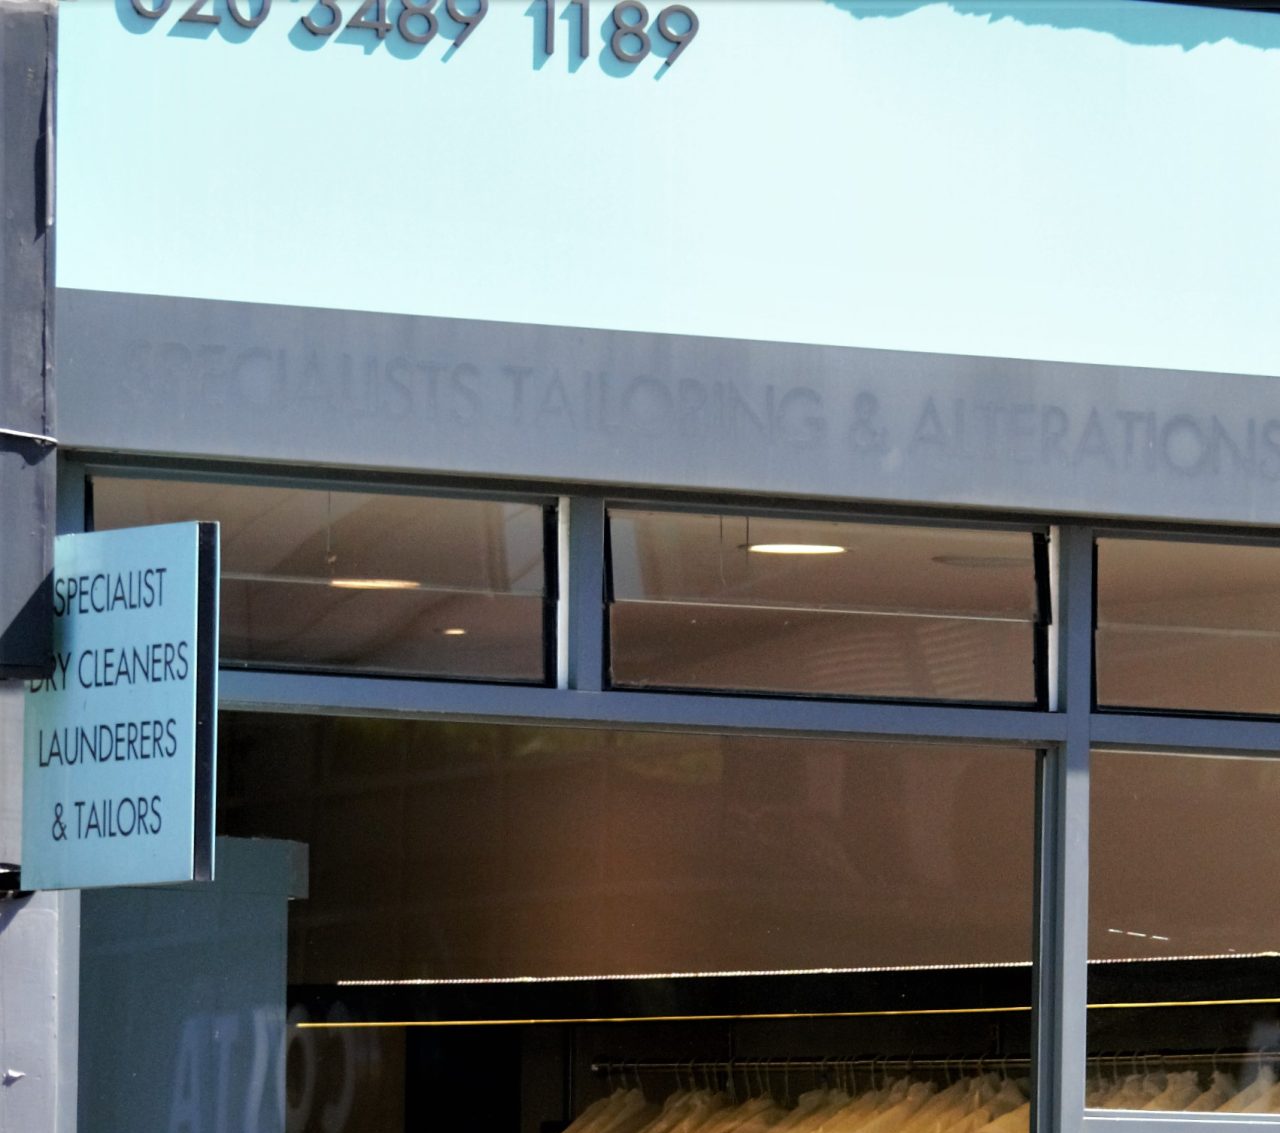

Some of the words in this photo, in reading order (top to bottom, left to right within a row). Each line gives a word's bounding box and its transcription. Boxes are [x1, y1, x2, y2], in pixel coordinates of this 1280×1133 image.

[535, 0, 699, 66] 1189
[53, 568, 167, 618] SPECIALIST
[78, 641, 189, 689] CLEANERS
[38, 718, 178, 768] LAUNDERERS
[51, 802, 68, 842] &
[75, 795, 163, 840] TAILORS
